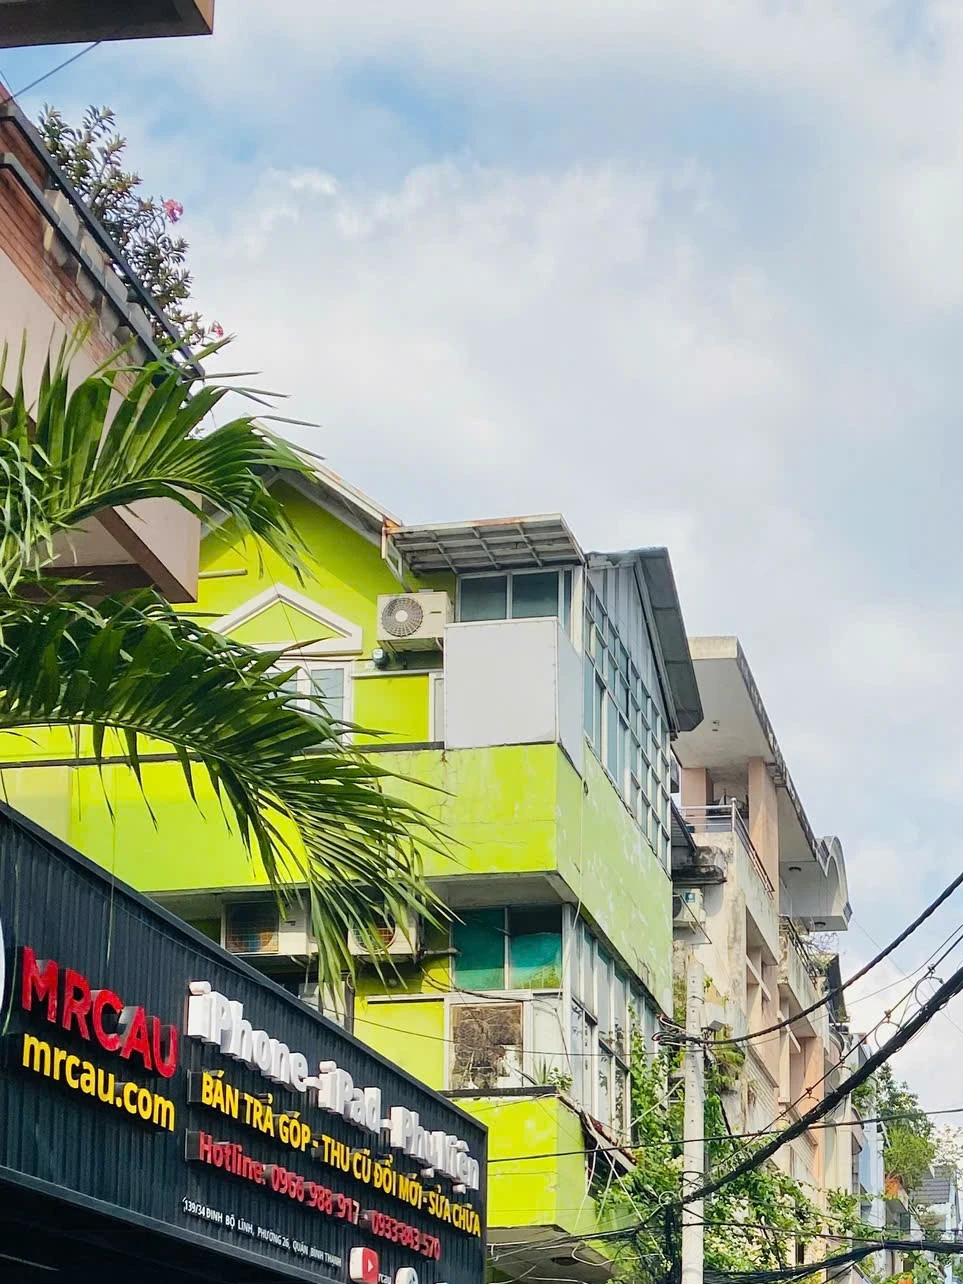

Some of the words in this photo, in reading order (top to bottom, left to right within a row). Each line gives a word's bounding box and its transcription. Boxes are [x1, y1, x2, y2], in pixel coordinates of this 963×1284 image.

[22, 945, 178, 1079] MRCAU
[23, 1033, 175, 1131] mrcau.com
[202, 1070, 239, 1119] BÁN
[244, 1093, 275, 1137] TRẢ
[279, 1111, 311, 1151] GÓP
[322, 1134, 350, 1172] THU
[352, 1149, 371, 1183] CŨ
[374, 1153, 397, 1196] ĐỔI
[399, 1173, 422, 1210] MỚI
[428, 1184, 451, 1223] SỬA
[452, 1204, 481, 1237] CHỮA
[272, 1164, 305, 1202] 0966
[307, 1182, 333, 1215] 988
[184, 1200, 206, 1217] 139/34
